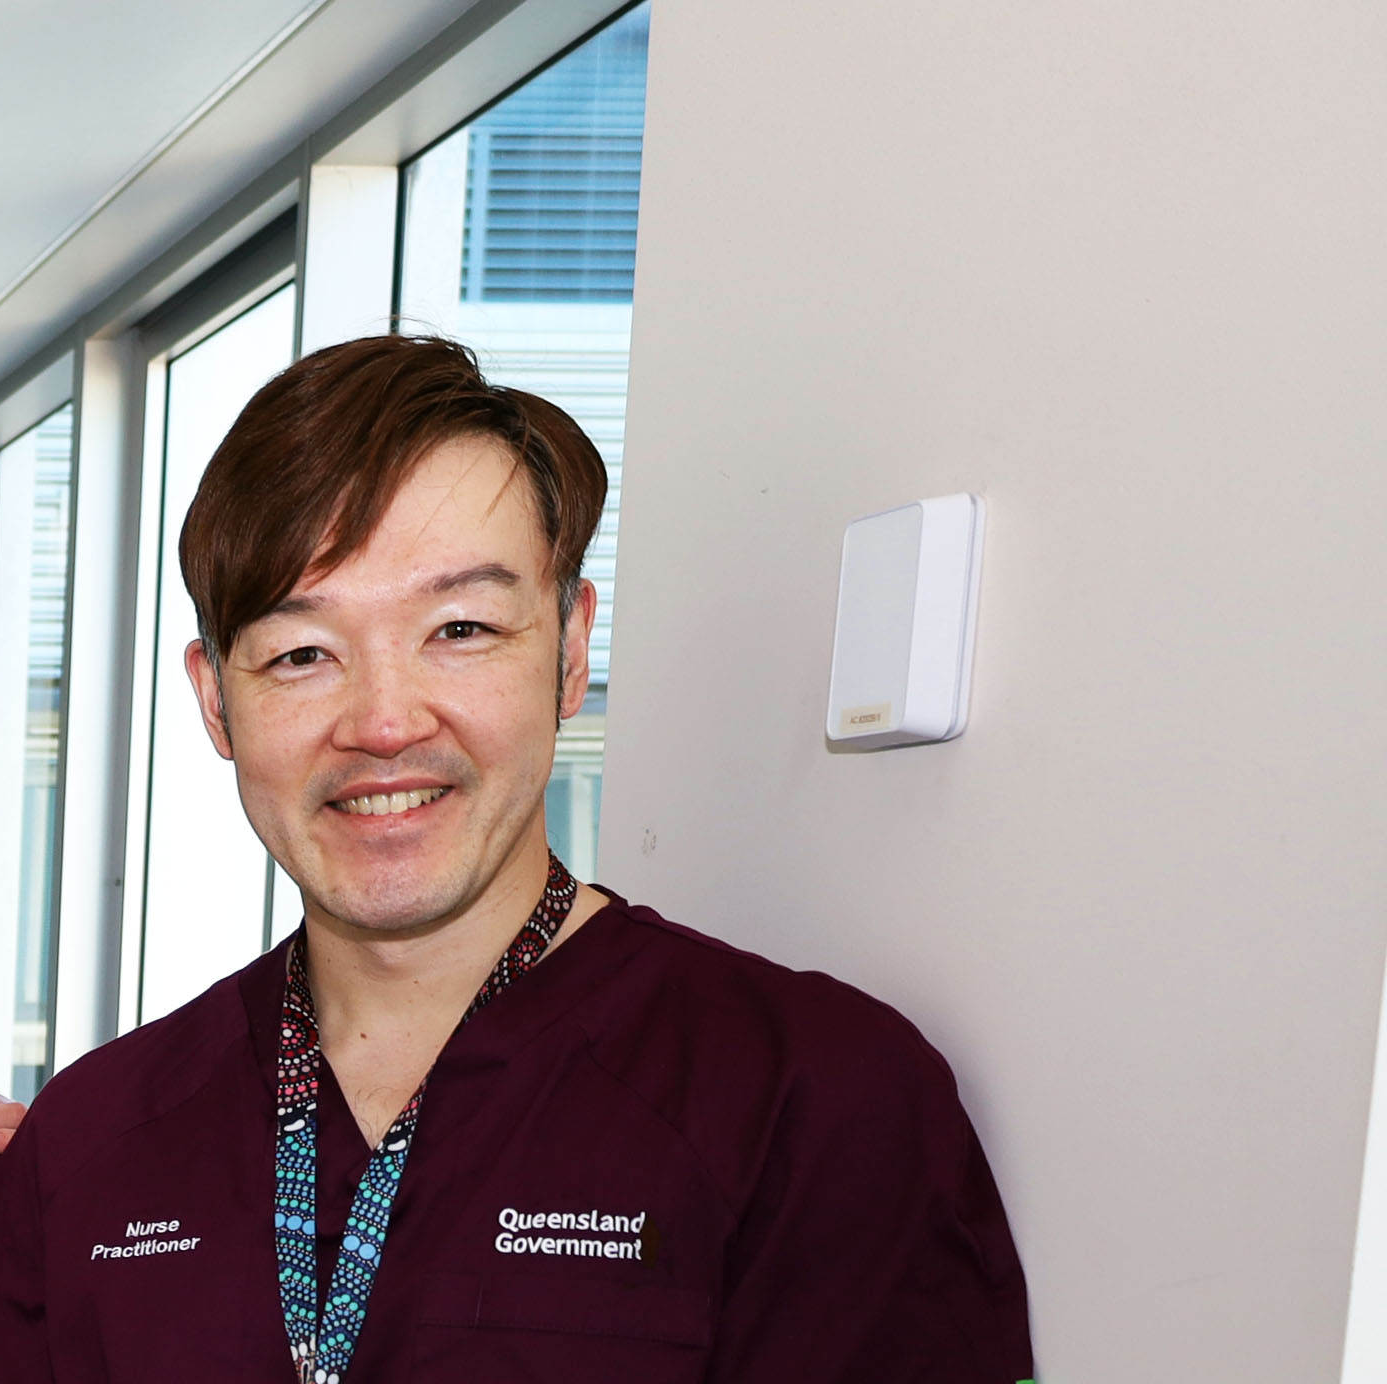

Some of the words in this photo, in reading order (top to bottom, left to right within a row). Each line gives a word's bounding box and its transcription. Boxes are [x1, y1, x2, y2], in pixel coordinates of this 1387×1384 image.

[125, 1219, 180, 1238] Nurse
[498, 1207, 646, 1233] Queensland
[90, 1237, 201, 1260] Practitioner
[494, 1232, 642, 1260] Government
